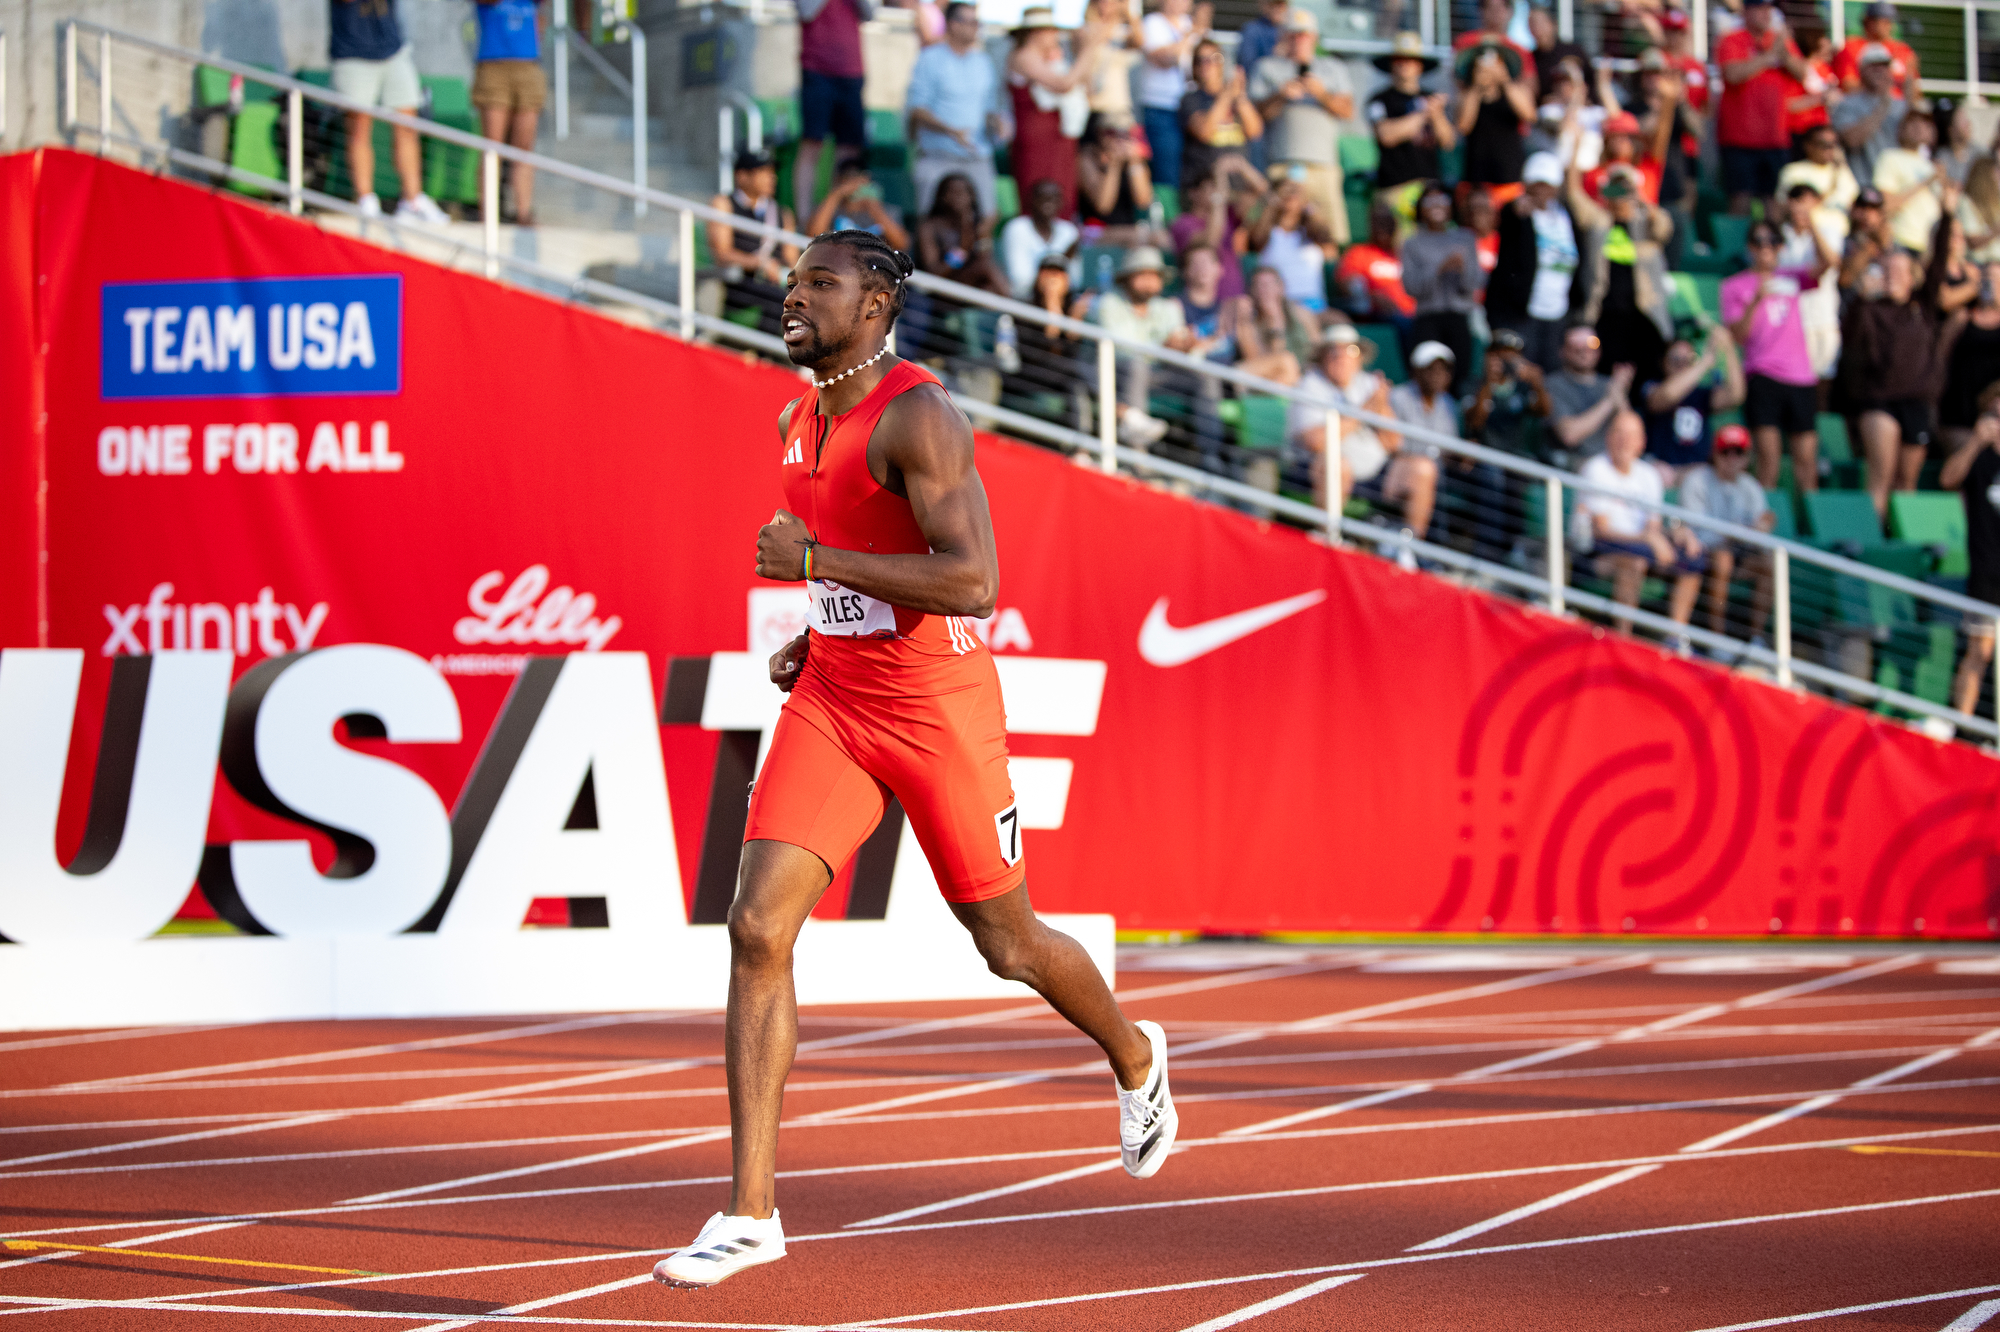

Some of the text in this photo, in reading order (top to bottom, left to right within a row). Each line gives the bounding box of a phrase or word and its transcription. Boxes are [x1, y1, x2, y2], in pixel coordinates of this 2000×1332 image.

[124, 301, 377, 374] TEAM USA
[98, 420, 405, 476] ONE FOR ALL
[102, 582, 330, 657] xfinity
[453, 563, 622, 652] Lilly
[820, 594, 865, 624] YLES
[1000, 806, 1018, 861] 7
